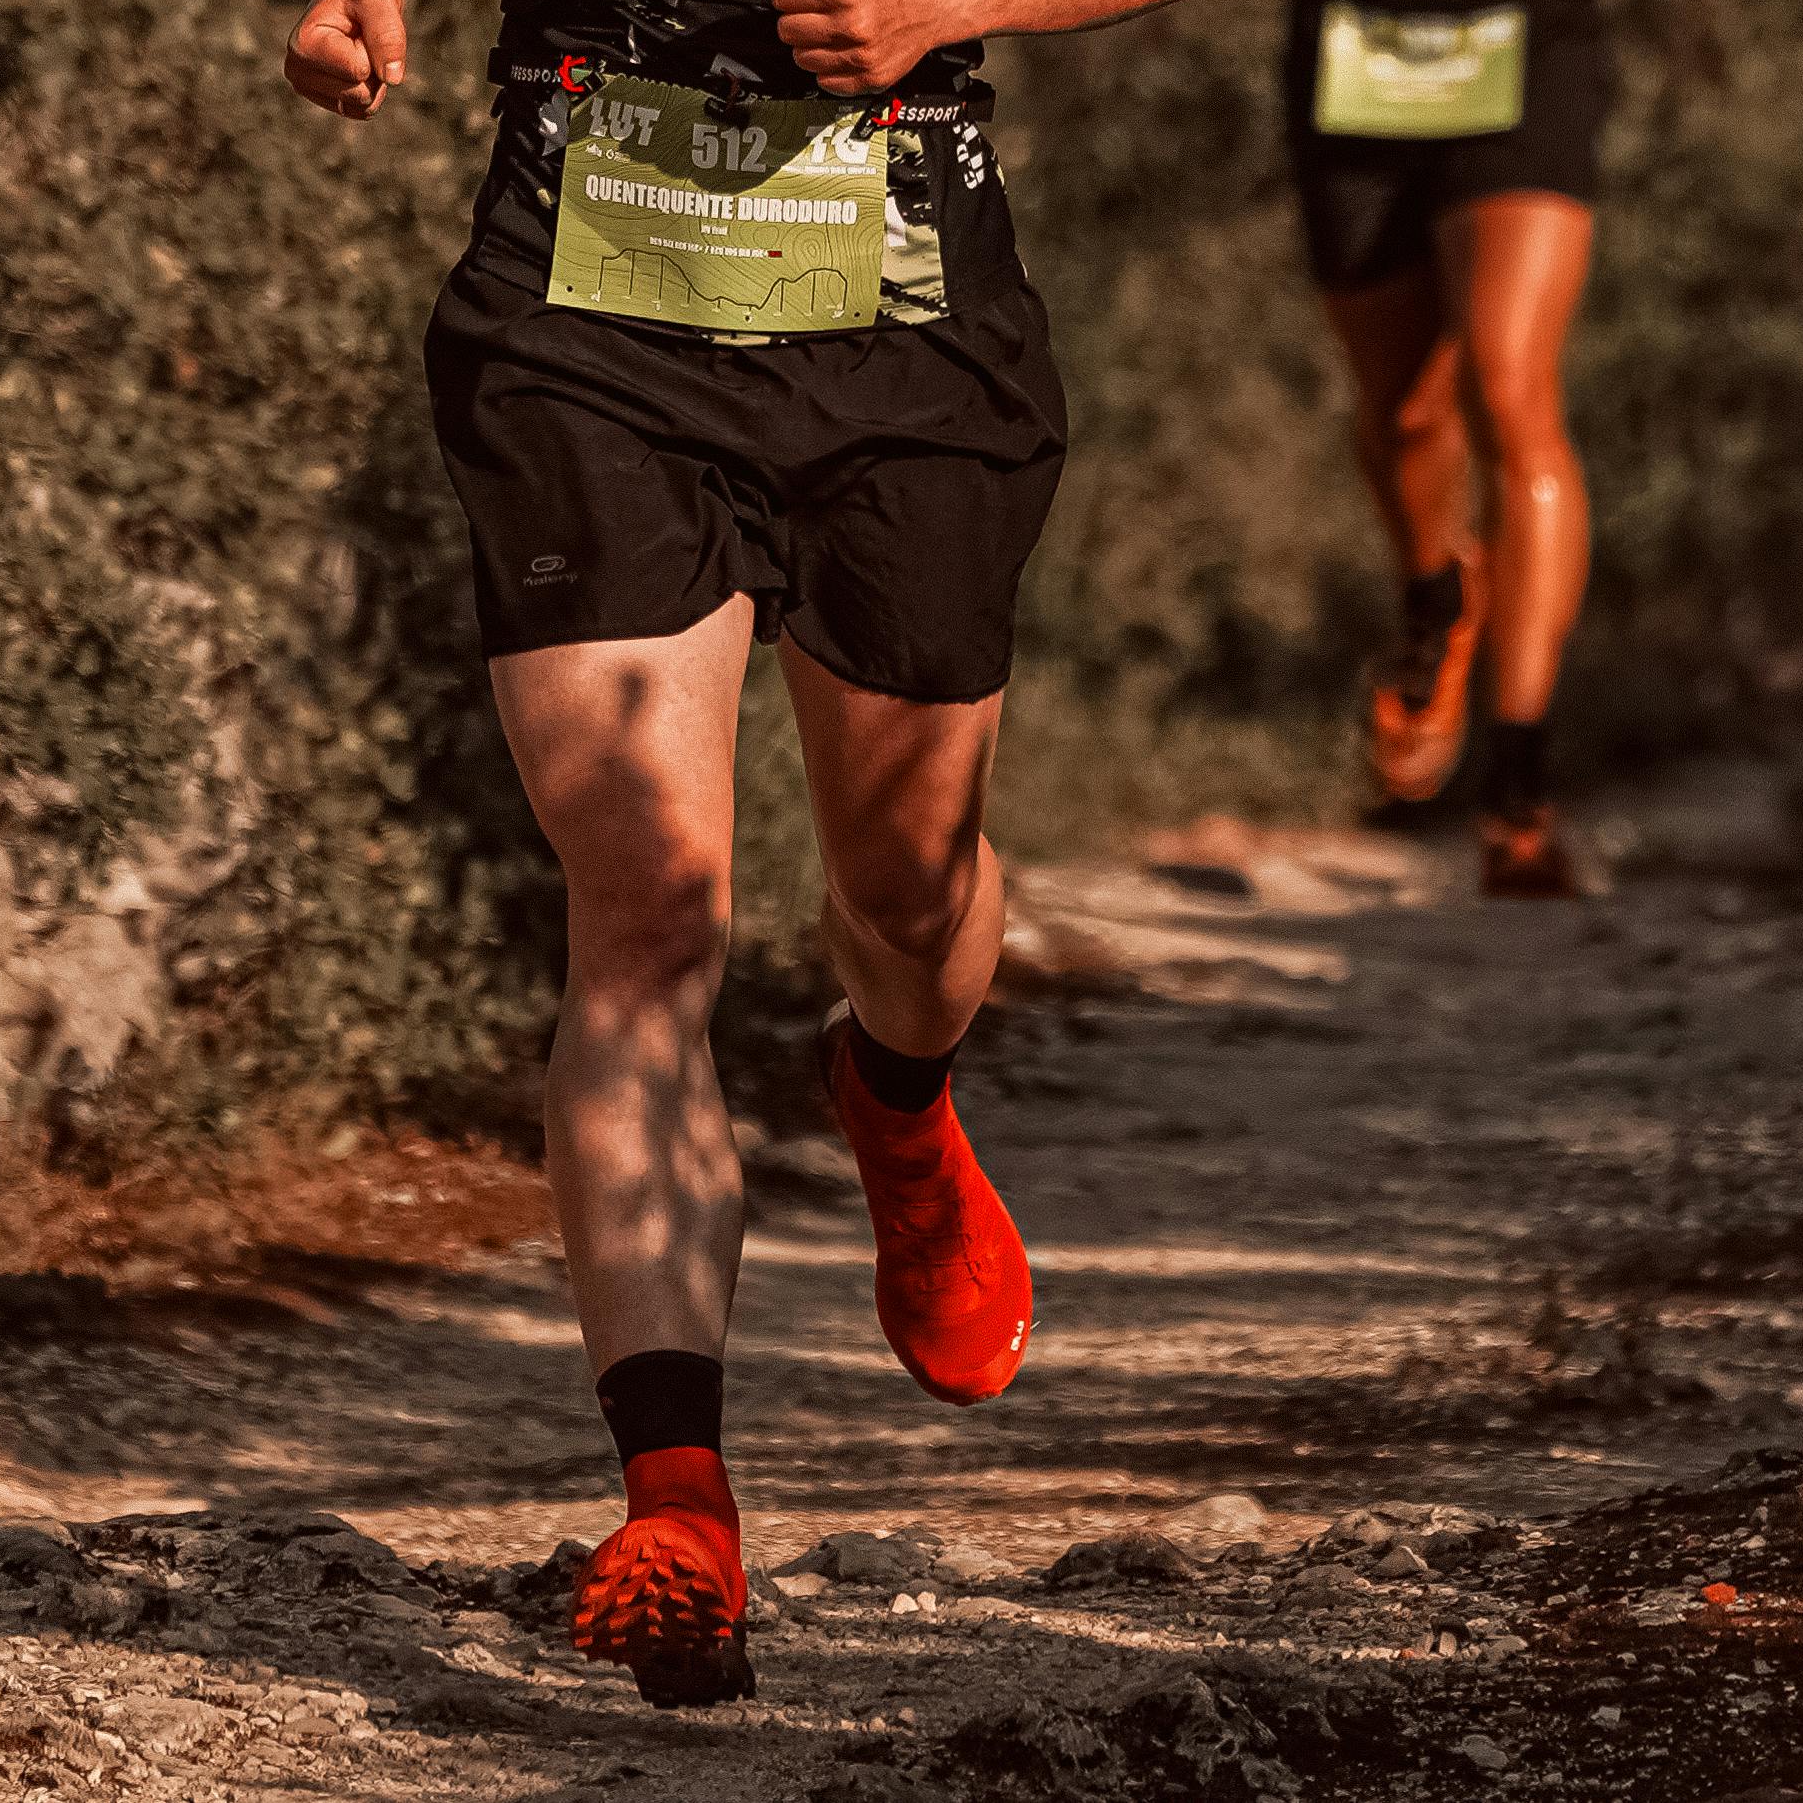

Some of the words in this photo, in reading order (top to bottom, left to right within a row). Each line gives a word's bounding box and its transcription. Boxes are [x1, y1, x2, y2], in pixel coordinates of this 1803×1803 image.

[691, 122, 767, 174] 512
[585, 174, 734, 221] QUENTEQUENTE
[737, 198, 859, 226] DURODURO
